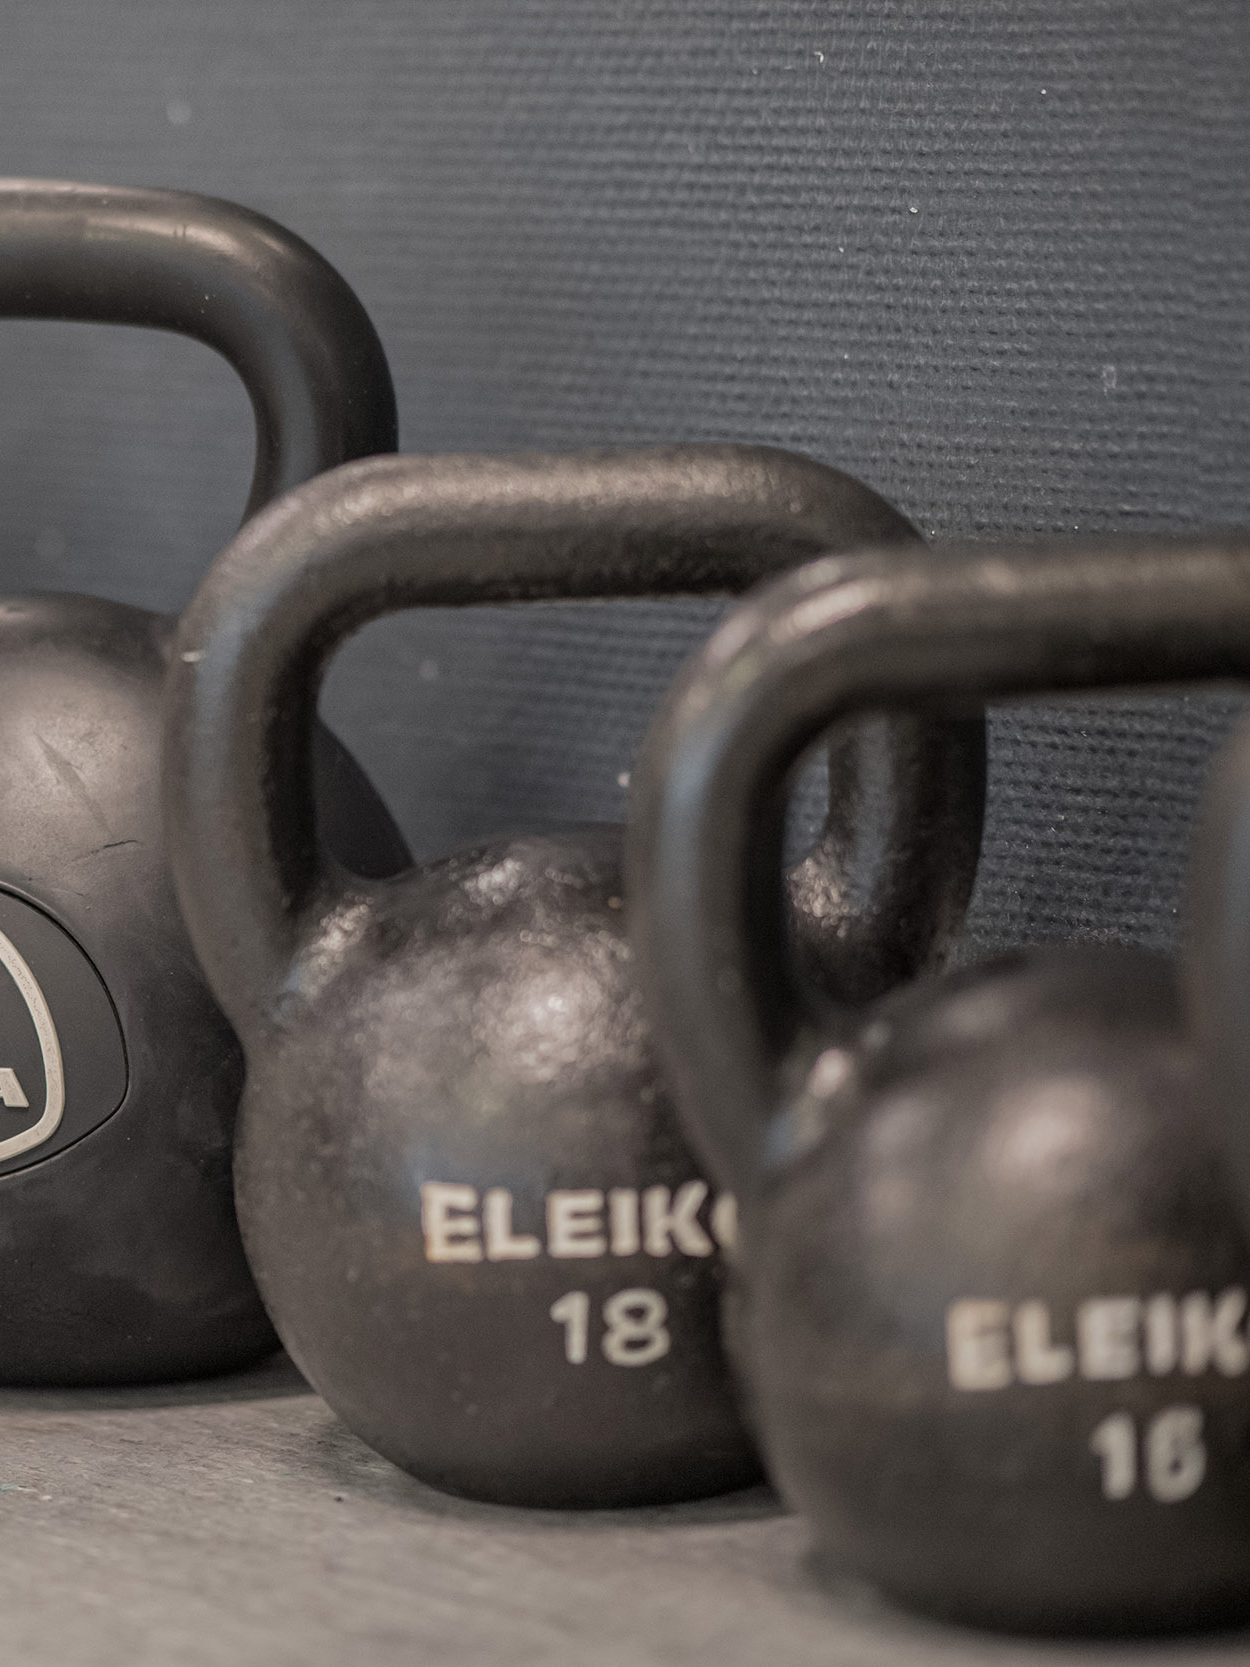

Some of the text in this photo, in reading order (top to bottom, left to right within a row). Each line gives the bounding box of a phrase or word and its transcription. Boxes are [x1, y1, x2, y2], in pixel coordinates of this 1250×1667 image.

[421, 1180, 738, 1264] ELEIK
[550, 1287, 671, 1368] 18
[945, 1285, 1250, 1392] ELEIK
[1090, 1406, 1206, 1503] 16
